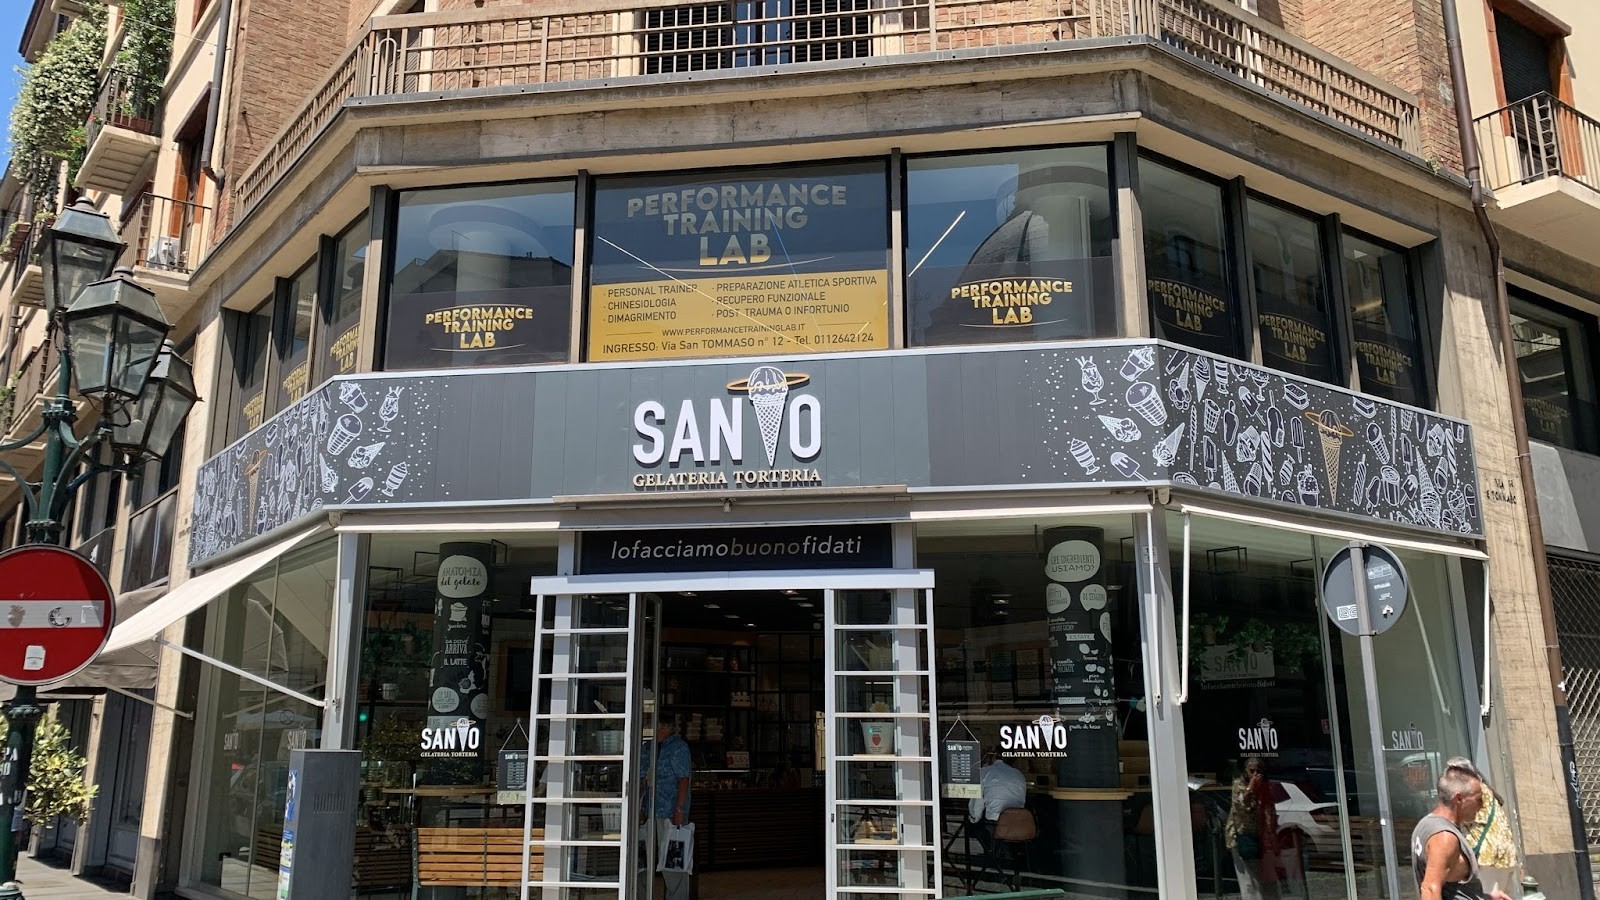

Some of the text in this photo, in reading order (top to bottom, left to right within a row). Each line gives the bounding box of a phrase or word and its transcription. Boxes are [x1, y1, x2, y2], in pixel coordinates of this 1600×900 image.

[627, 183, 847, 218] PERFORMANCE
[663, 206, 808, 236] TRAINING
[699, 233, 772, 266] LAB
[607, 283, 698, 298] PERSONAL TRAINER
[716, 275, 877, 292] PREPARAZIONE ATLETICA SPORTIVA
[951, 280, 1073, 299] PERFORMANCE
[607, 298, 677, 311] CHINESIOLOGIA
[716, 291, 826, 305] RECUPERO FUNZIONALE
[971, 292, 1052, 308] TRAINING
[1148, 279, 1226, 312] PERFORMANCE
[744, 307, 783, 317] TRAUMA
[784, 306, 792, 315] O
[793, 303, 850, 315] INFORTUNIO
[992, 306, 1033, 324] LAB
[1161, 293, 1214, 319] TRAINING
[425, 307, 534, 324] PERFORMANCE
[607, 311, 677, 323] DIMAGRIMENTO
[1175, 309, 1203, 332] LAB
[443, 318, 514, 333] TRAINING
[661, 323, 806, 337] WWW.PERFORMANCETRAININGLAB.IT
[1259, 314, 1326, 343] PERFORMANCE
[460, 331, 496, 349] LAB
[602, 341, 659, 354] INGRESSO:
[661, 341, 677, 351] Via
[679, 340, 699, 350] San
[701, 337, 755, 350] TOMMASO
[773, 336, 784, 346] 12
[794, 335, 811, 346] Tel.
[814, 332, 874, 345] 0112642124
[1271, 327, 1316, 350] TRAINING
[1284, 341, 1307, 362] LAB
[1364, 352, 1404, 373] TRAINING
[1375, 366, 1397, 385] LAB
[633, 468, 822, 488] GELATERIA TORTERIA
[442, 566, 482, 577] ANATOMIA
[1051, 564, 1095, 573] USIAMO?
[445, 643, 468, 655] ARRIVA
[450, 657, 468, 666] LATTE
